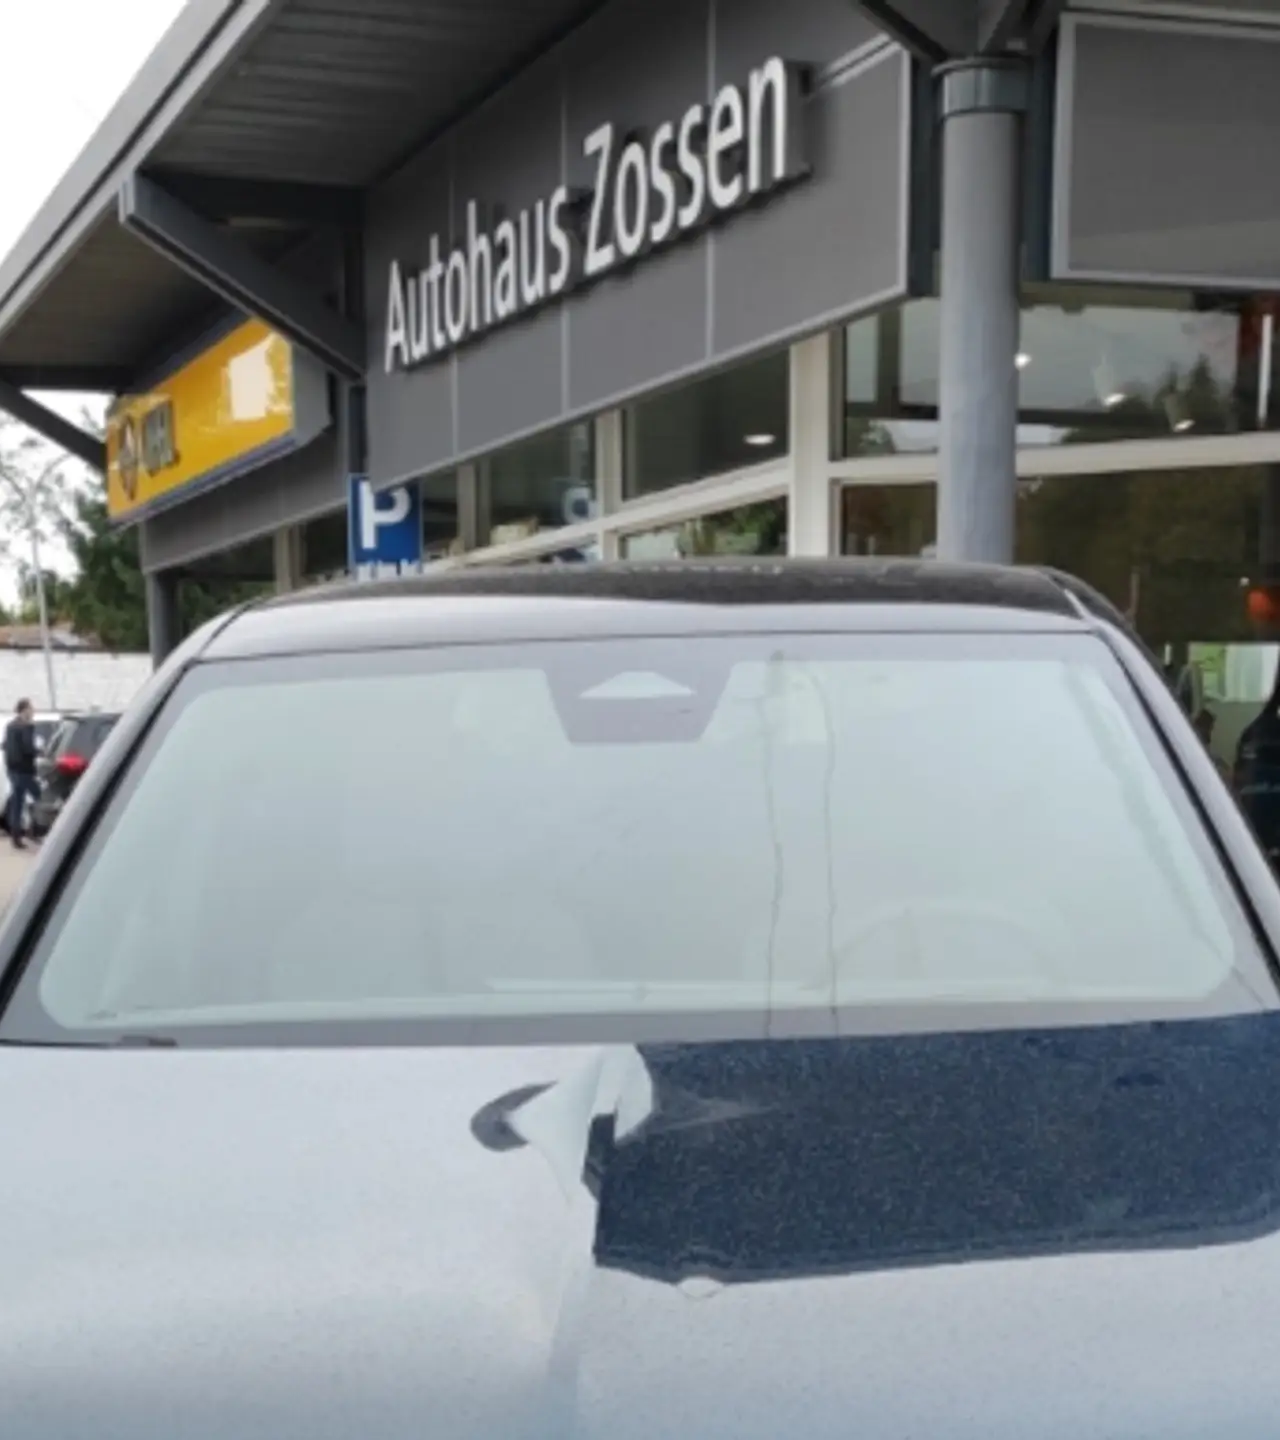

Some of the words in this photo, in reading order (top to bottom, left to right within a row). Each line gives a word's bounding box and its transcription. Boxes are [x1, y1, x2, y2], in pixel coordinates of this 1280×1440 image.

[384, 186, 570, 373] Autohaus
[583, 56, 787, 275] Zossen
[358, 480, 412, 550] P
